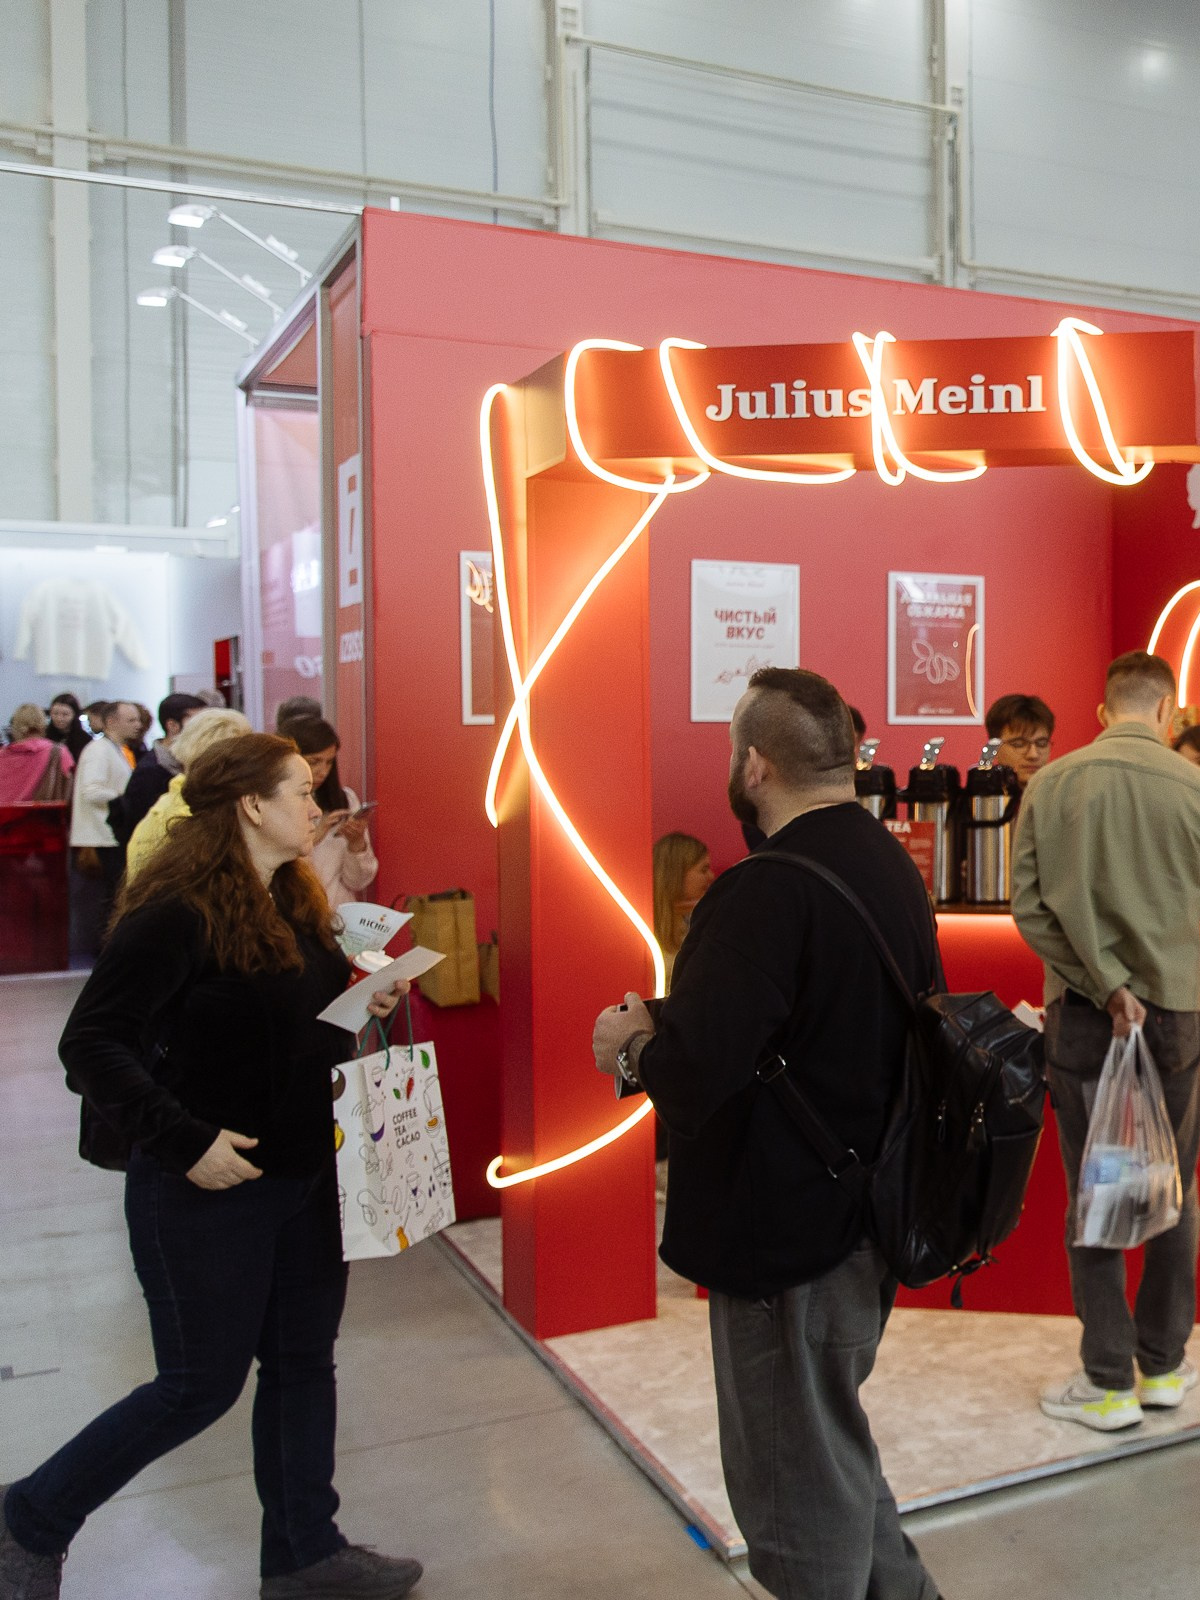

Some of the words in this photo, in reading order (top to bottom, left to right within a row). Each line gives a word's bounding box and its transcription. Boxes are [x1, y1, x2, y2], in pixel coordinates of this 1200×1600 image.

[705, 379, 872, 422] Julius
[892, 373, 1048, 417] Meinl
[714, 606, 777, 624] ЧИСТЫЙ
[726, 626, 765, 640] ВКУС
[392, 1107, 417, 1125] COFFEE
[394, 1124, 407, 1138] TEA
[396, 1130, 420, 1149] CACAO
